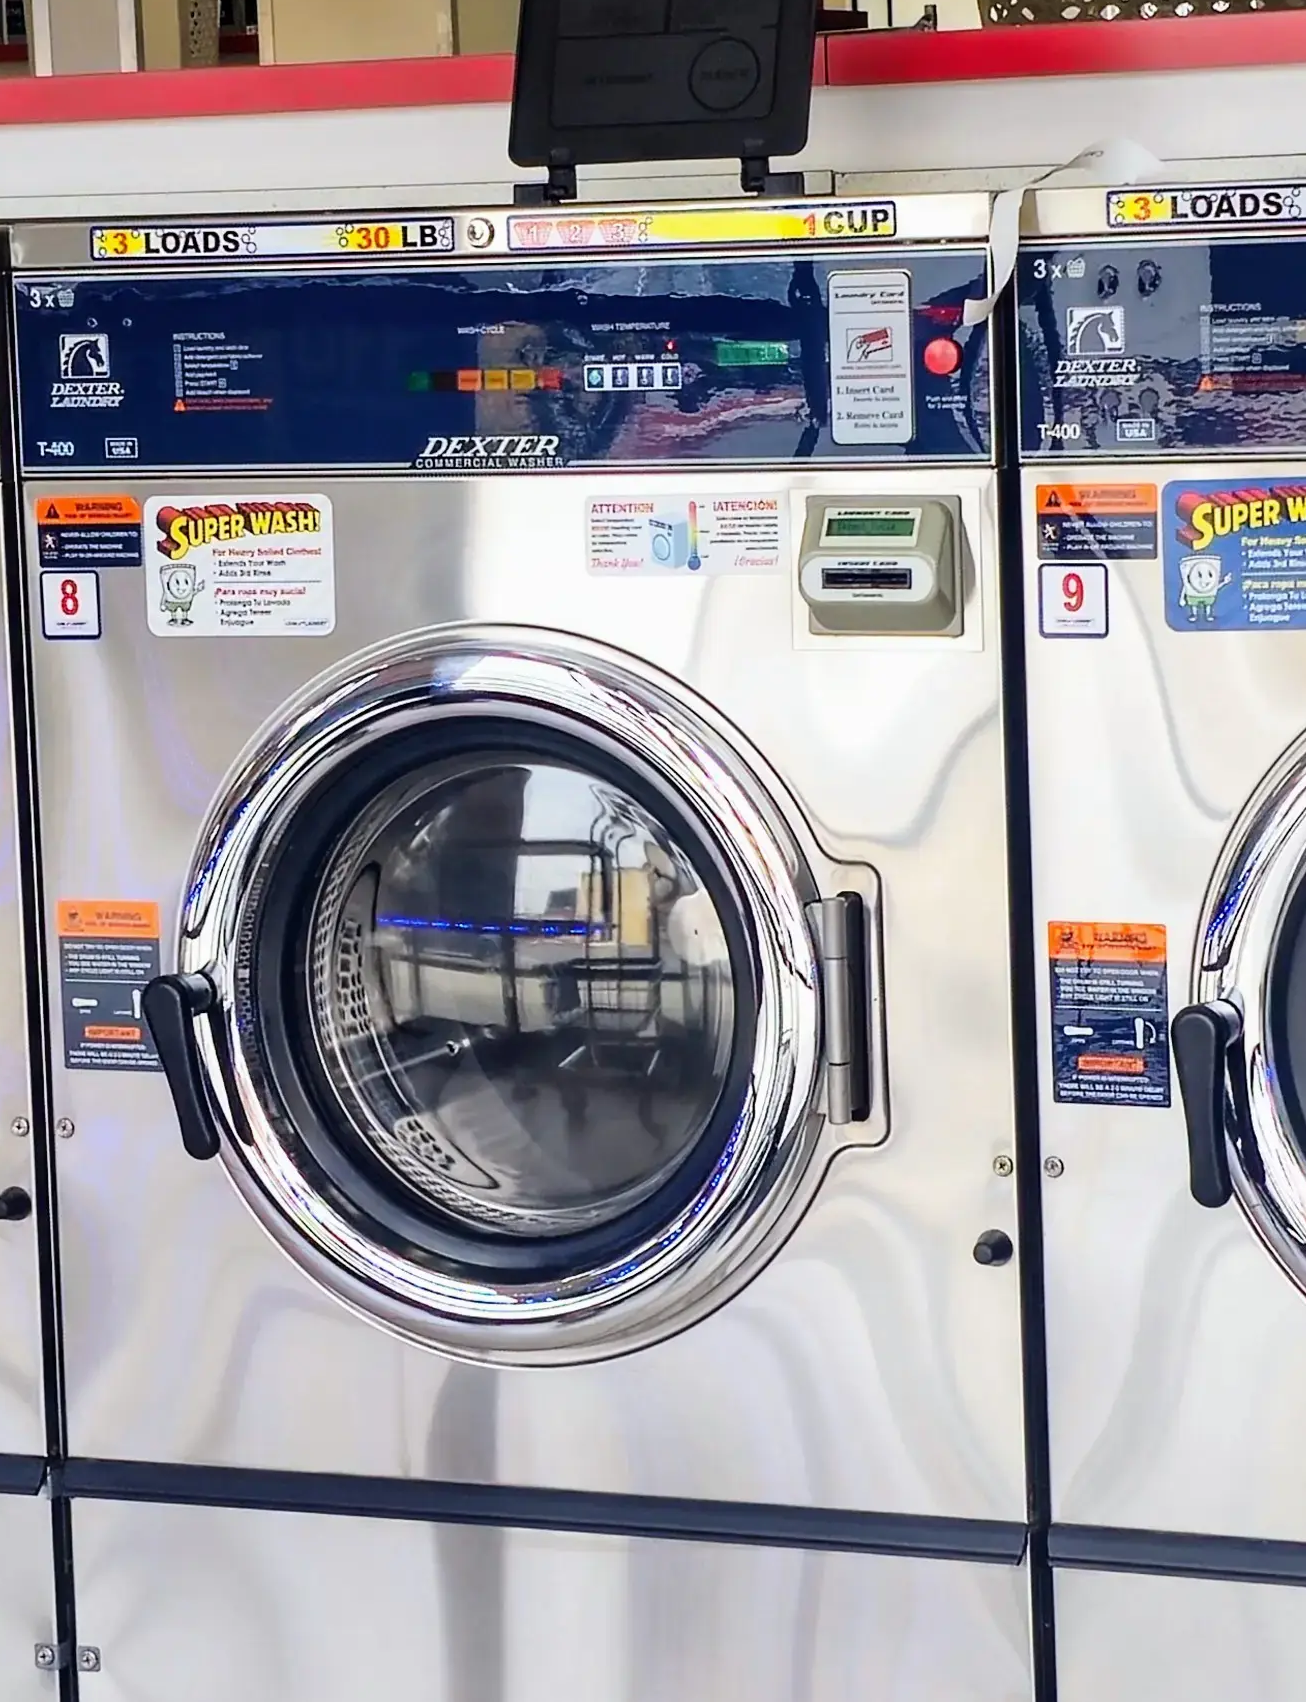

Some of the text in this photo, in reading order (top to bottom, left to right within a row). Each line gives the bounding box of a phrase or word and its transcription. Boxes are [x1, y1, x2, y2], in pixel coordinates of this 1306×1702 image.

[1133, 198, 1150, 221] 3
[1170, 192, 1282, 219] LOADS
[803, 209, 889, 235] 1 CUP
[113, 225, 438, 254] 3 LOADS 30 LB
[1034, 259, 1046, 278] 3
[1055, 358, 1137, 373] DEXTER
[51, 382, 121, 396] DEXTER
[1037, 424, 1080, 439] T-400
[37, 441, 74, 457] T-400
[419, 435, 559, 457] DEXTER
[415, 456, 564, 468] COMMERCIAL WASHER
[591, 503, 654, 514] ATTENTION
[170, 514, 245, 560] SUPER
[251, 510, 321, 535] WASH!
[1192, 500, 1281, 551] SUPER
[1241, 537, 1257, 546] For
[61, 579, 79, 615] 8
[1062, 573, 1084, 612] 9
